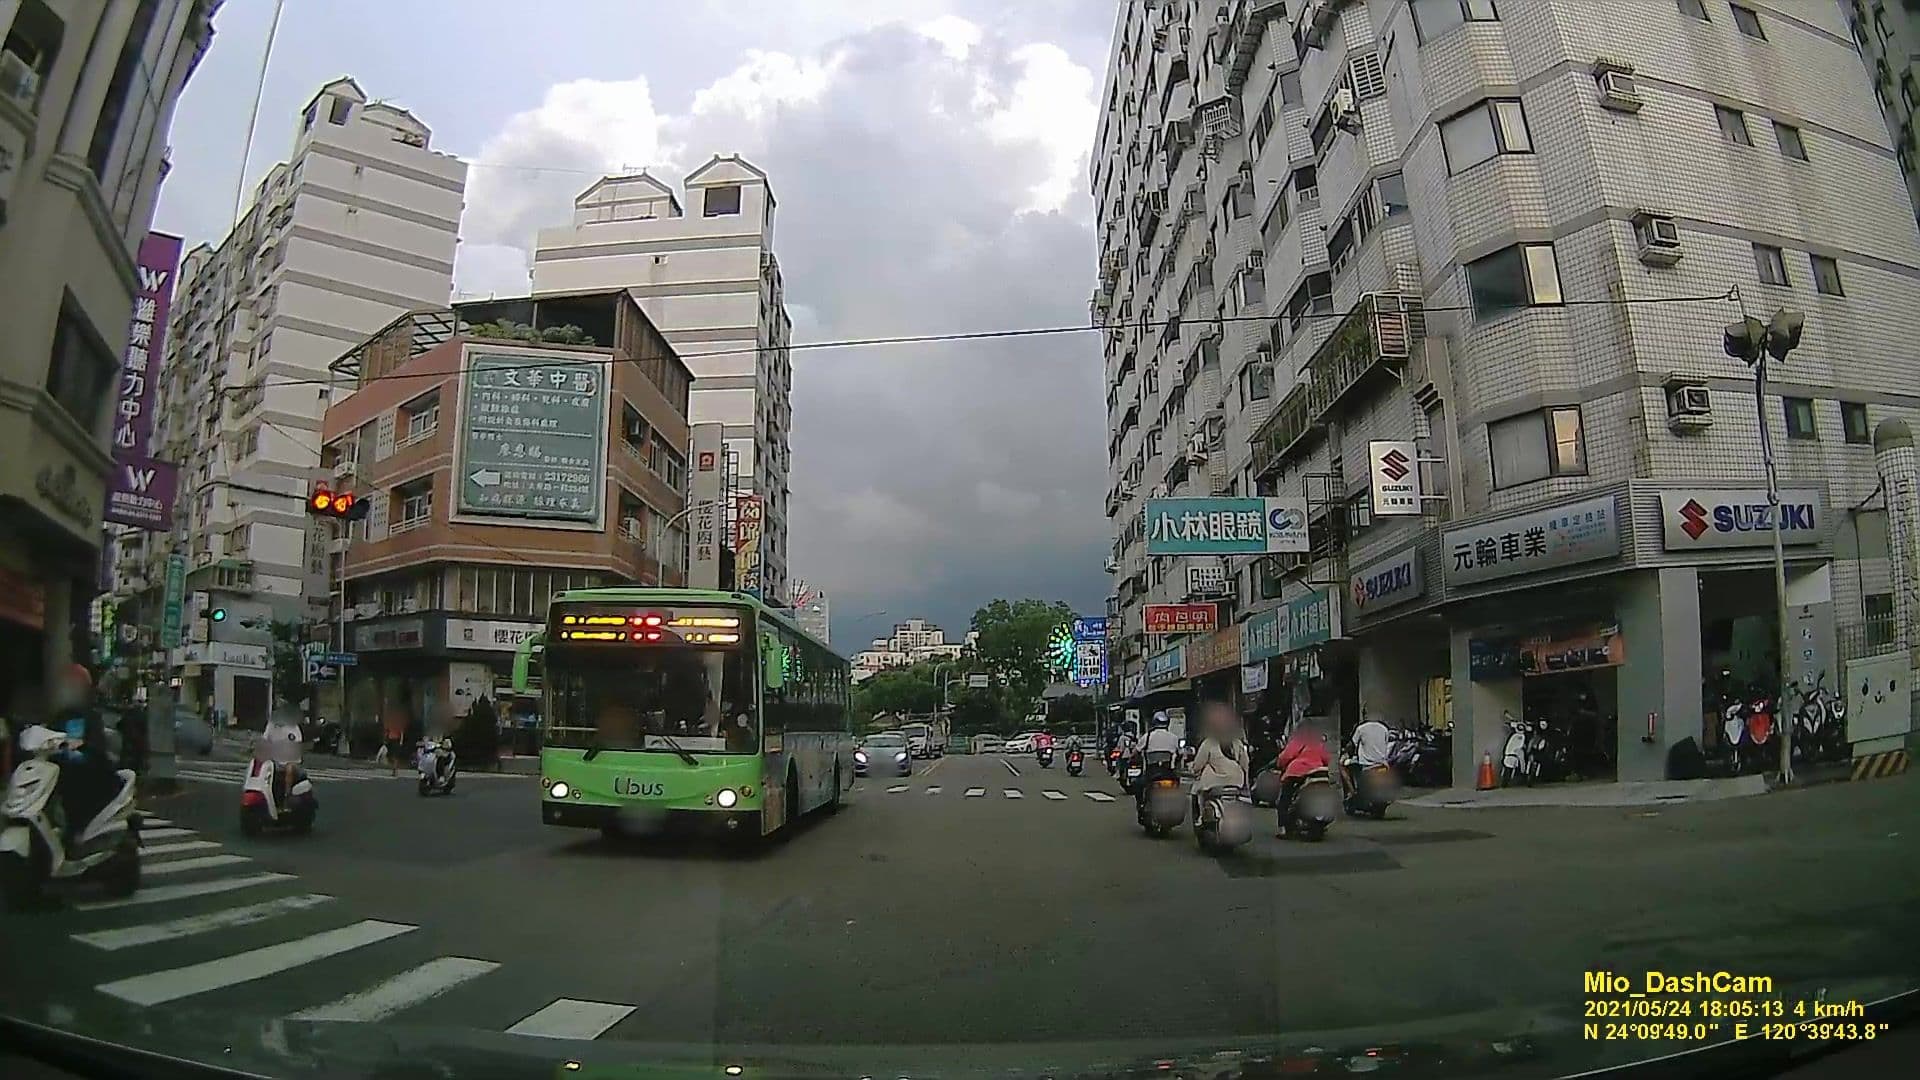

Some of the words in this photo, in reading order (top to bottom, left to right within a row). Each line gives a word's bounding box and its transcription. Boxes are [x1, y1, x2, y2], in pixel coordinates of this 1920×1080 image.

[504, 369, 590, 391] 文華中醫
[1151, 511, 1263, 542] 小林眼鏡
[1713, 504, 1815, 531] SUZUKI
[1453, 526, 1547, 572] 元輪車業
[1366, 562, 1411, 600] SUZUKI
